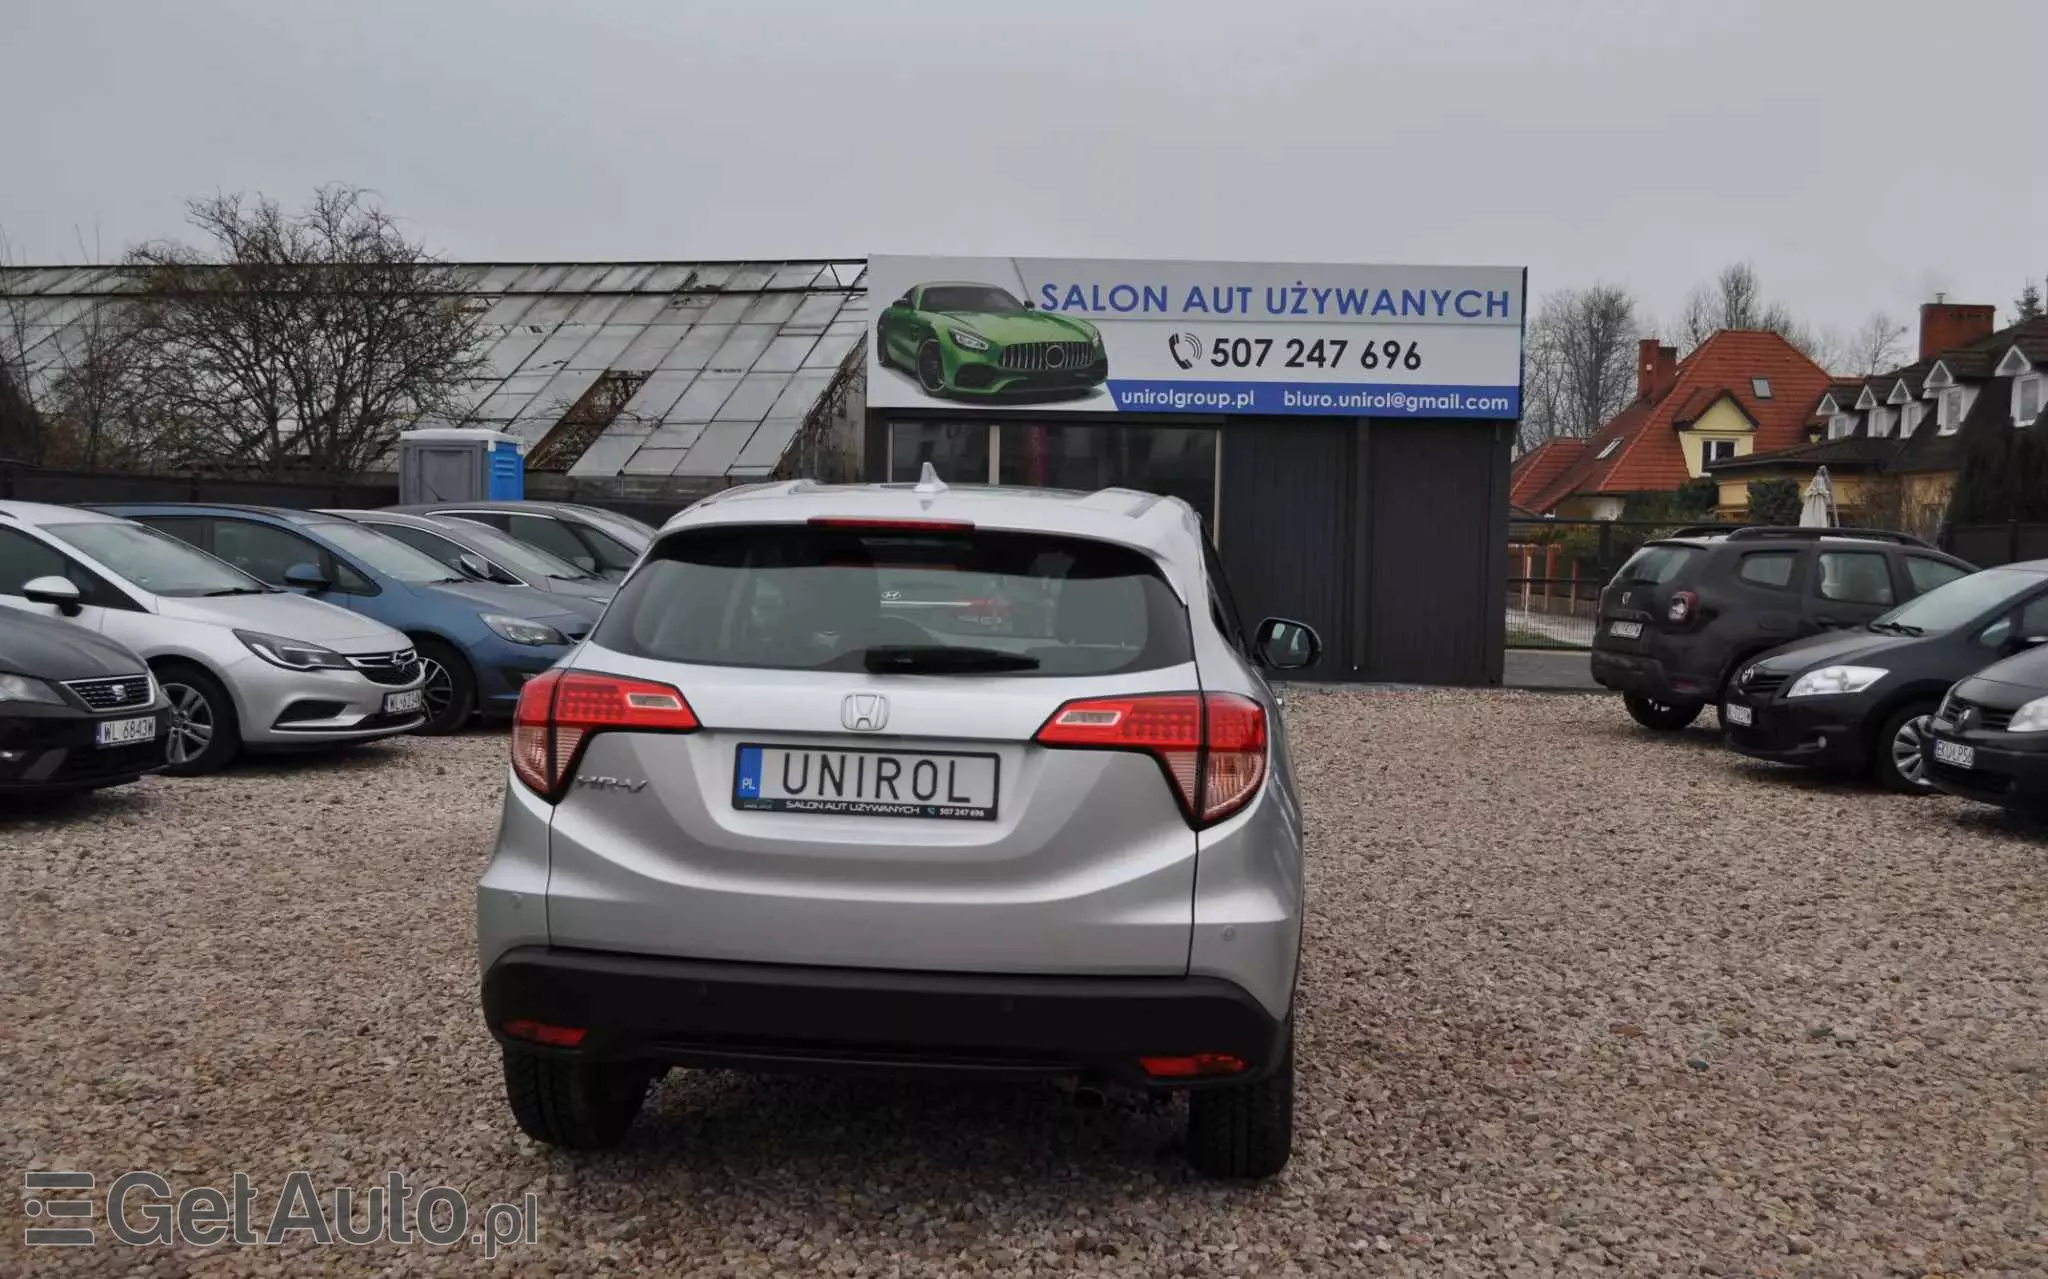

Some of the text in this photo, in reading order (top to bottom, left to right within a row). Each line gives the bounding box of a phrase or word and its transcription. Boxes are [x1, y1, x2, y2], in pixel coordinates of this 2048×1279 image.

[1041, 280, 1509, 318] SALON AUT UŻYWANYCH
[1210, 338, 1422, 371] 507 247 696
[1121, 388, 1255, 409] unirolgroup.pl
[1283, 391, 1509, 412] biuro.unirol@gmail.com
[104, 722, 120, 741] WL
[742, 778, 756, 790] PL
[782, 752, 971, 803] UNIROL
[785, 800, 824, 810] SALON
[824, 802, 848, 811] AUT
[939, 806, 953, 816] 507
[954, 807, 969, 817] 247
